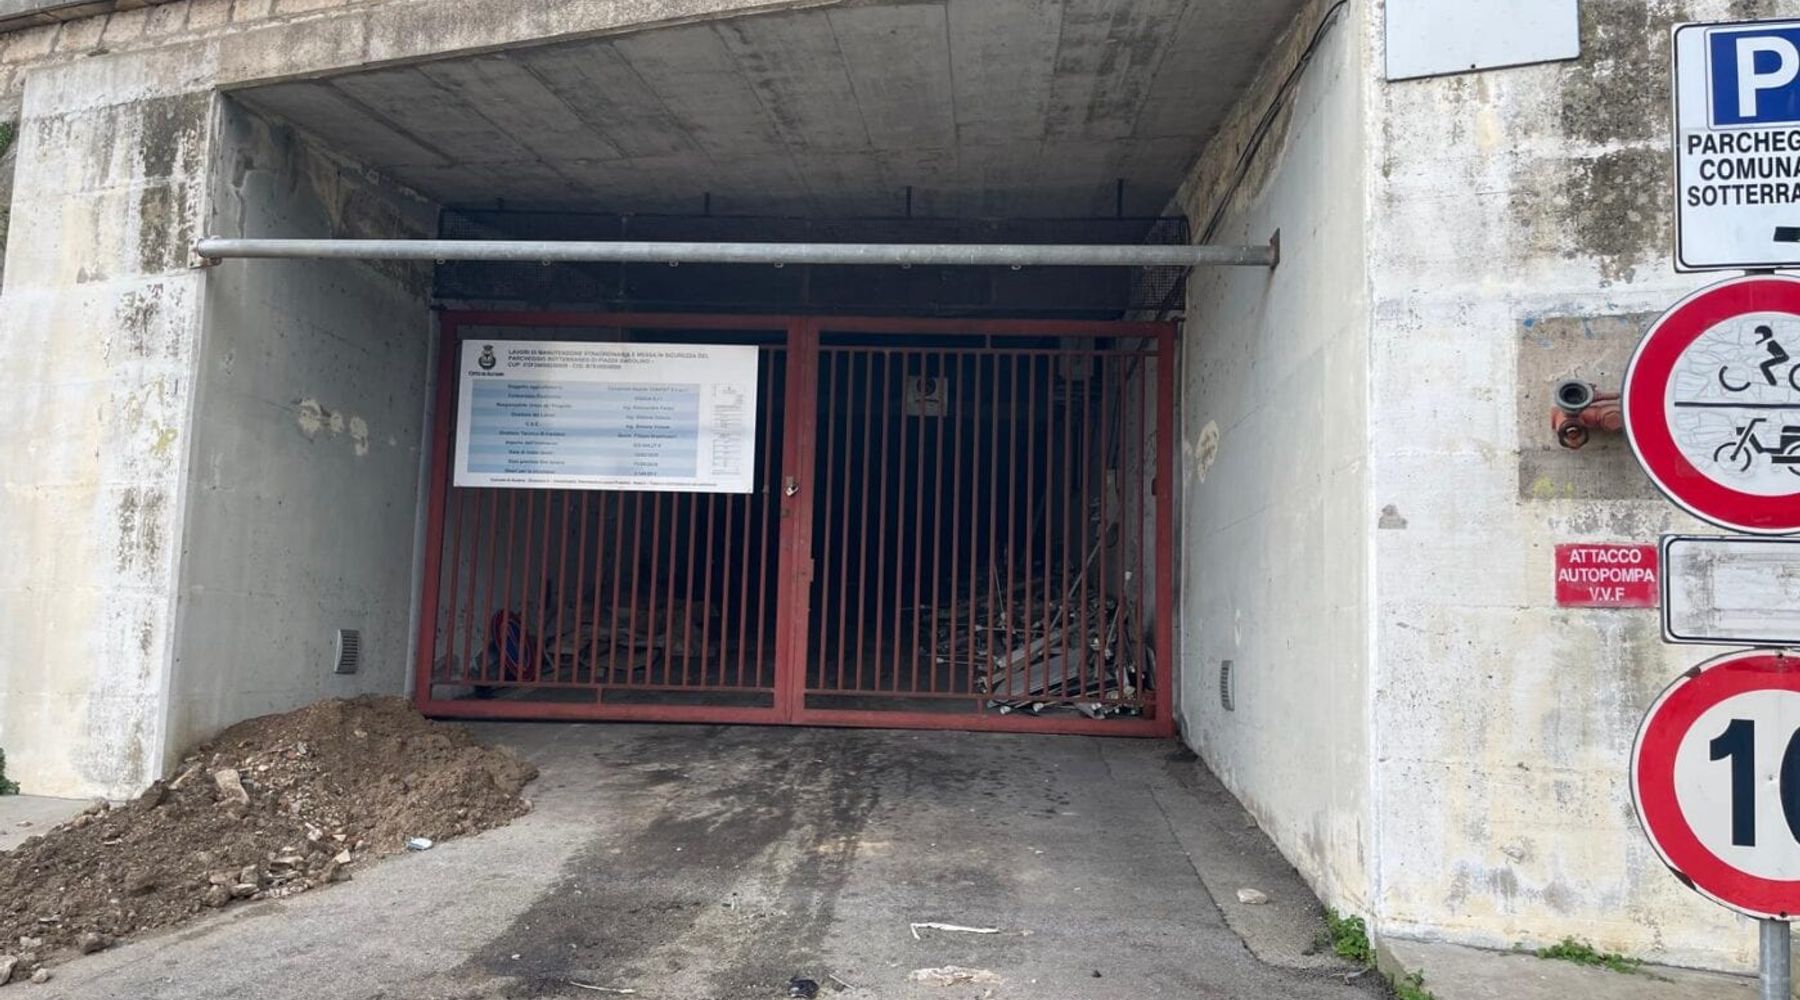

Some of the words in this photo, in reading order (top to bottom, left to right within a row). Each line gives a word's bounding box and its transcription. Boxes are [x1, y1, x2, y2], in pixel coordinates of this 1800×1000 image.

[1736, 36, 1800, 118] P
[1687, 131, 1800, 155] PARCHEG
[1687, 183, 1800, 207] SOTTERRA
[1569, 548, 1642, 563] ATTACCO
[1558, 568, 1655, 582] AUTOPOMPA
